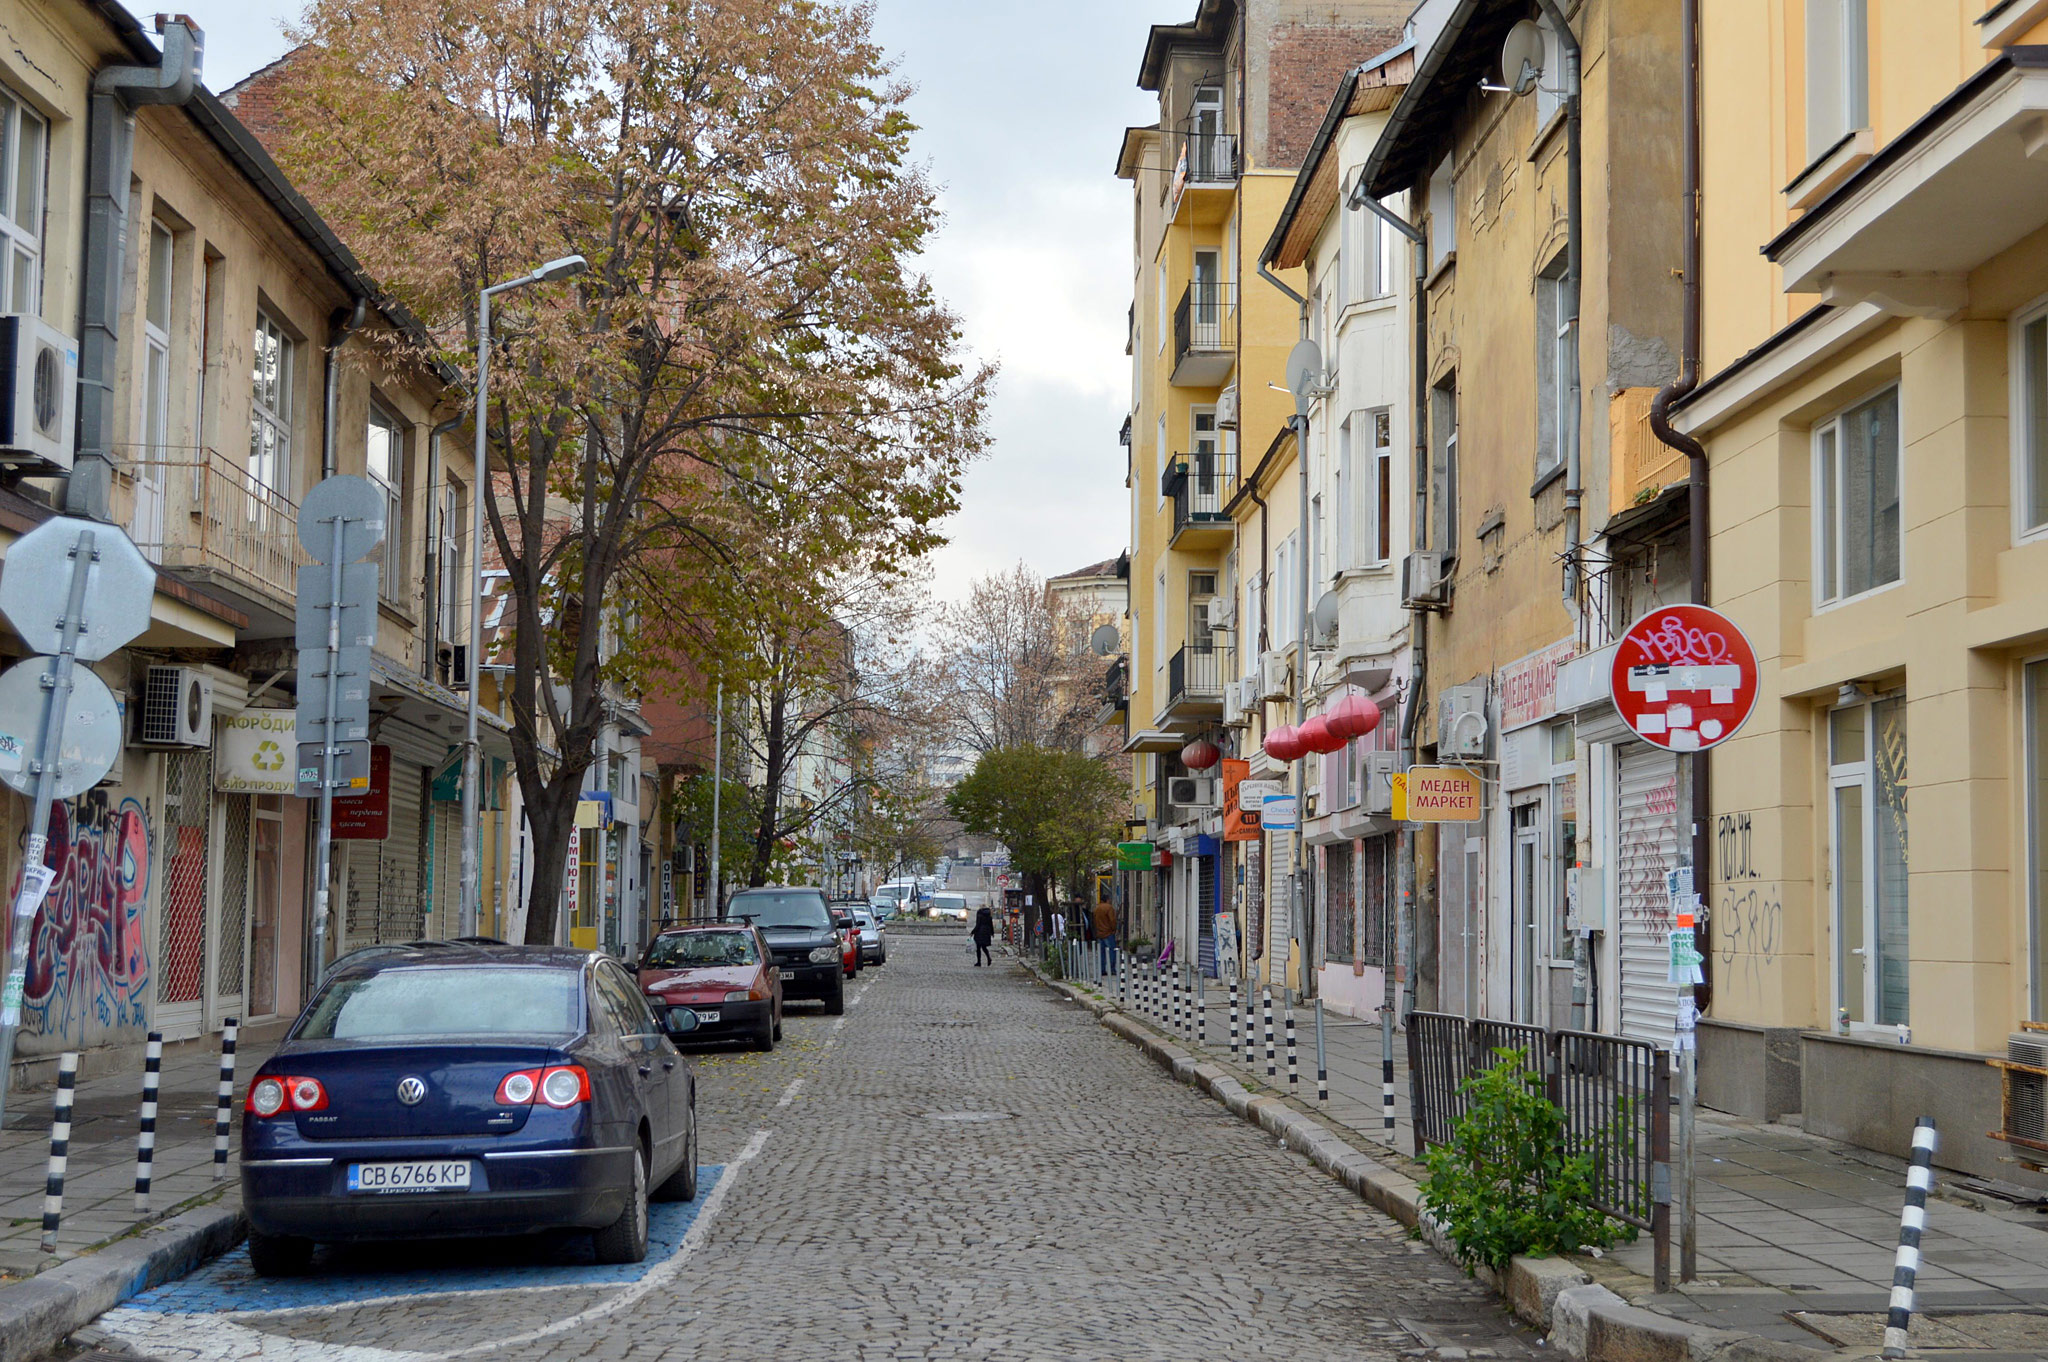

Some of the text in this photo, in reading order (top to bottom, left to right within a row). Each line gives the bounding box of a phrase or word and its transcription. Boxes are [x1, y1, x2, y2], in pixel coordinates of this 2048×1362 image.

[226, 714, 295, 733] АФРОДИ
[249, 780, 295, 791] ПРОДУК
[1420, 780, 1470, 794] МЕДЕН
[1416, 796, 1474, 808] МАРКЕТ
[568, 825, 579, 910] КОМПЮТРИ
[663, 863, 671, 920] ОПТИКА
[362, 1164, 466, 1186] CB 6766 KP
[377, 1186, 440, 1194] ПРЕСТИЖ
